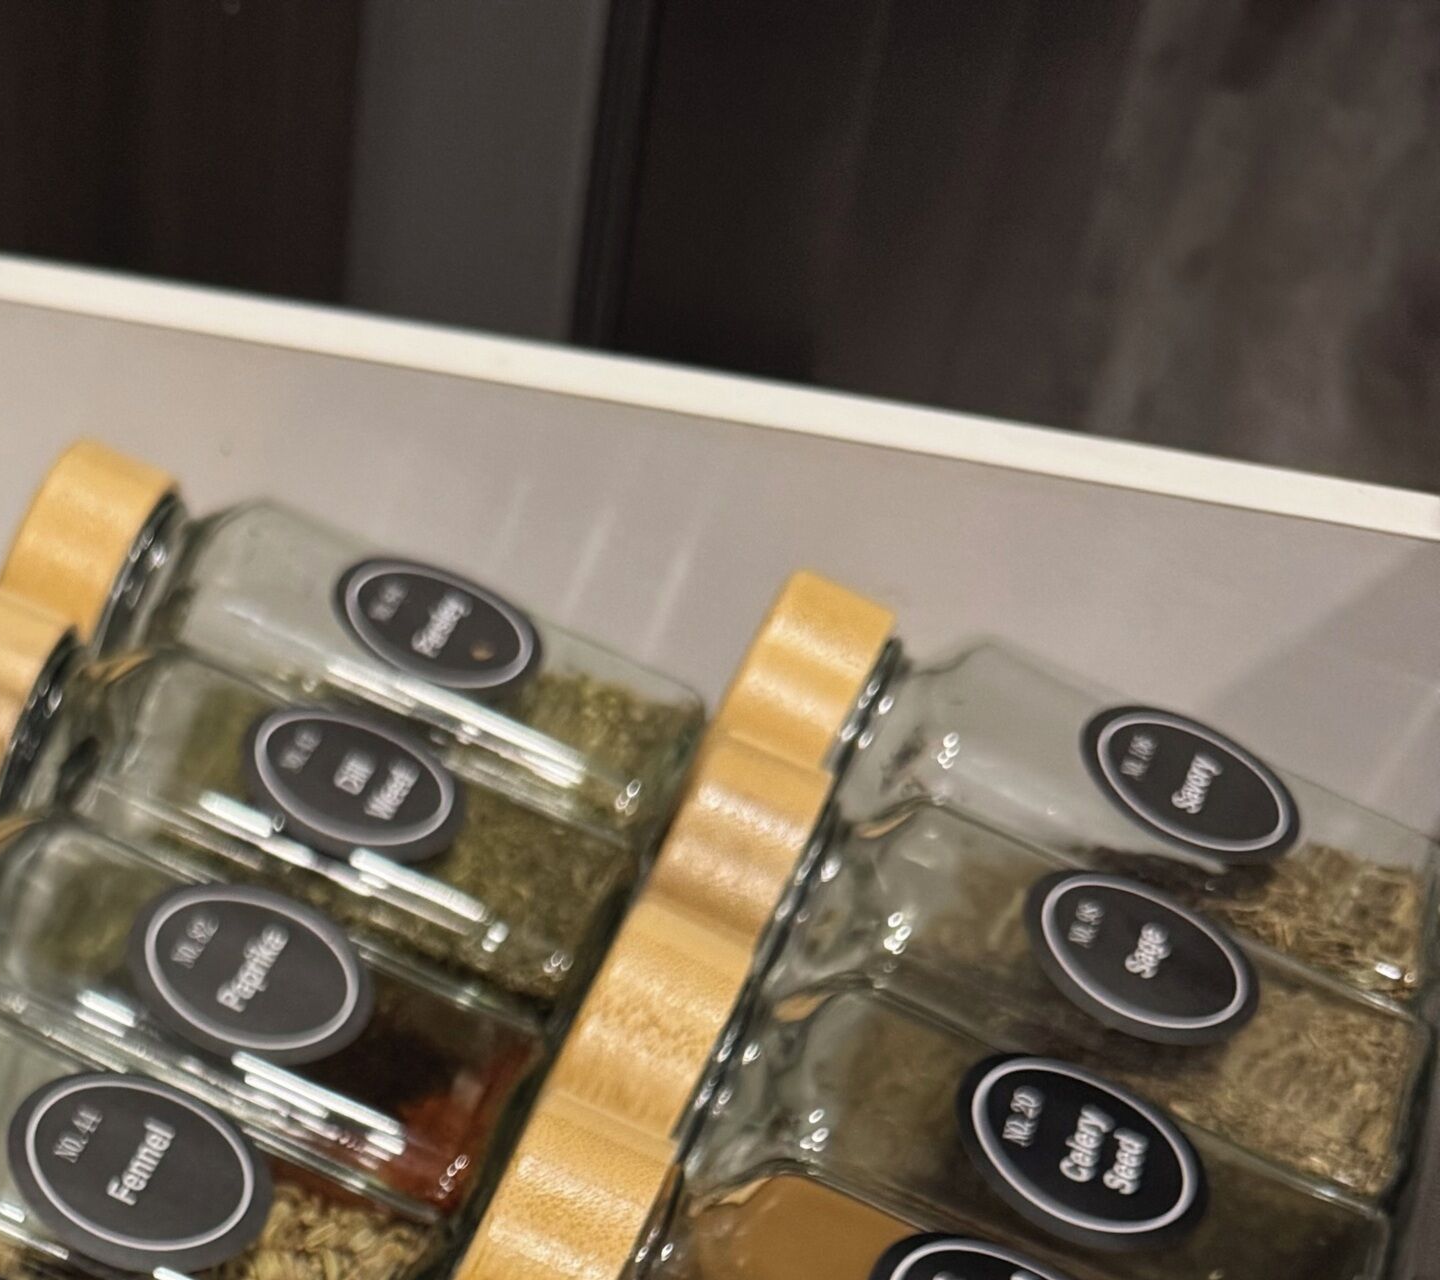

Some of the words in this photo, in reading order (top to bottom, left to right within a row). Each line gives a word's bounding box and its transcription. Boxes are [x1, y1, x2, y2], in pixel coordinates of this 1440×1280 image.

[333, 753, 374, 796] Dill
[364, 763, 418, 821] Weed
[1171, 754, 1222, 814] Savory
[216, 928, 288, 1013] Paprika
[1124, 924, 1170, 979] Sage
[1002, 1116, 1036, 1147] NO.
[1010, 1087, 1042, 1127] 20
[106, 1118, 175, 1206] Fennel
[1059, 1108, 1111, 1183] Celery
[1102, 1131, 1147, 1195] Seed
